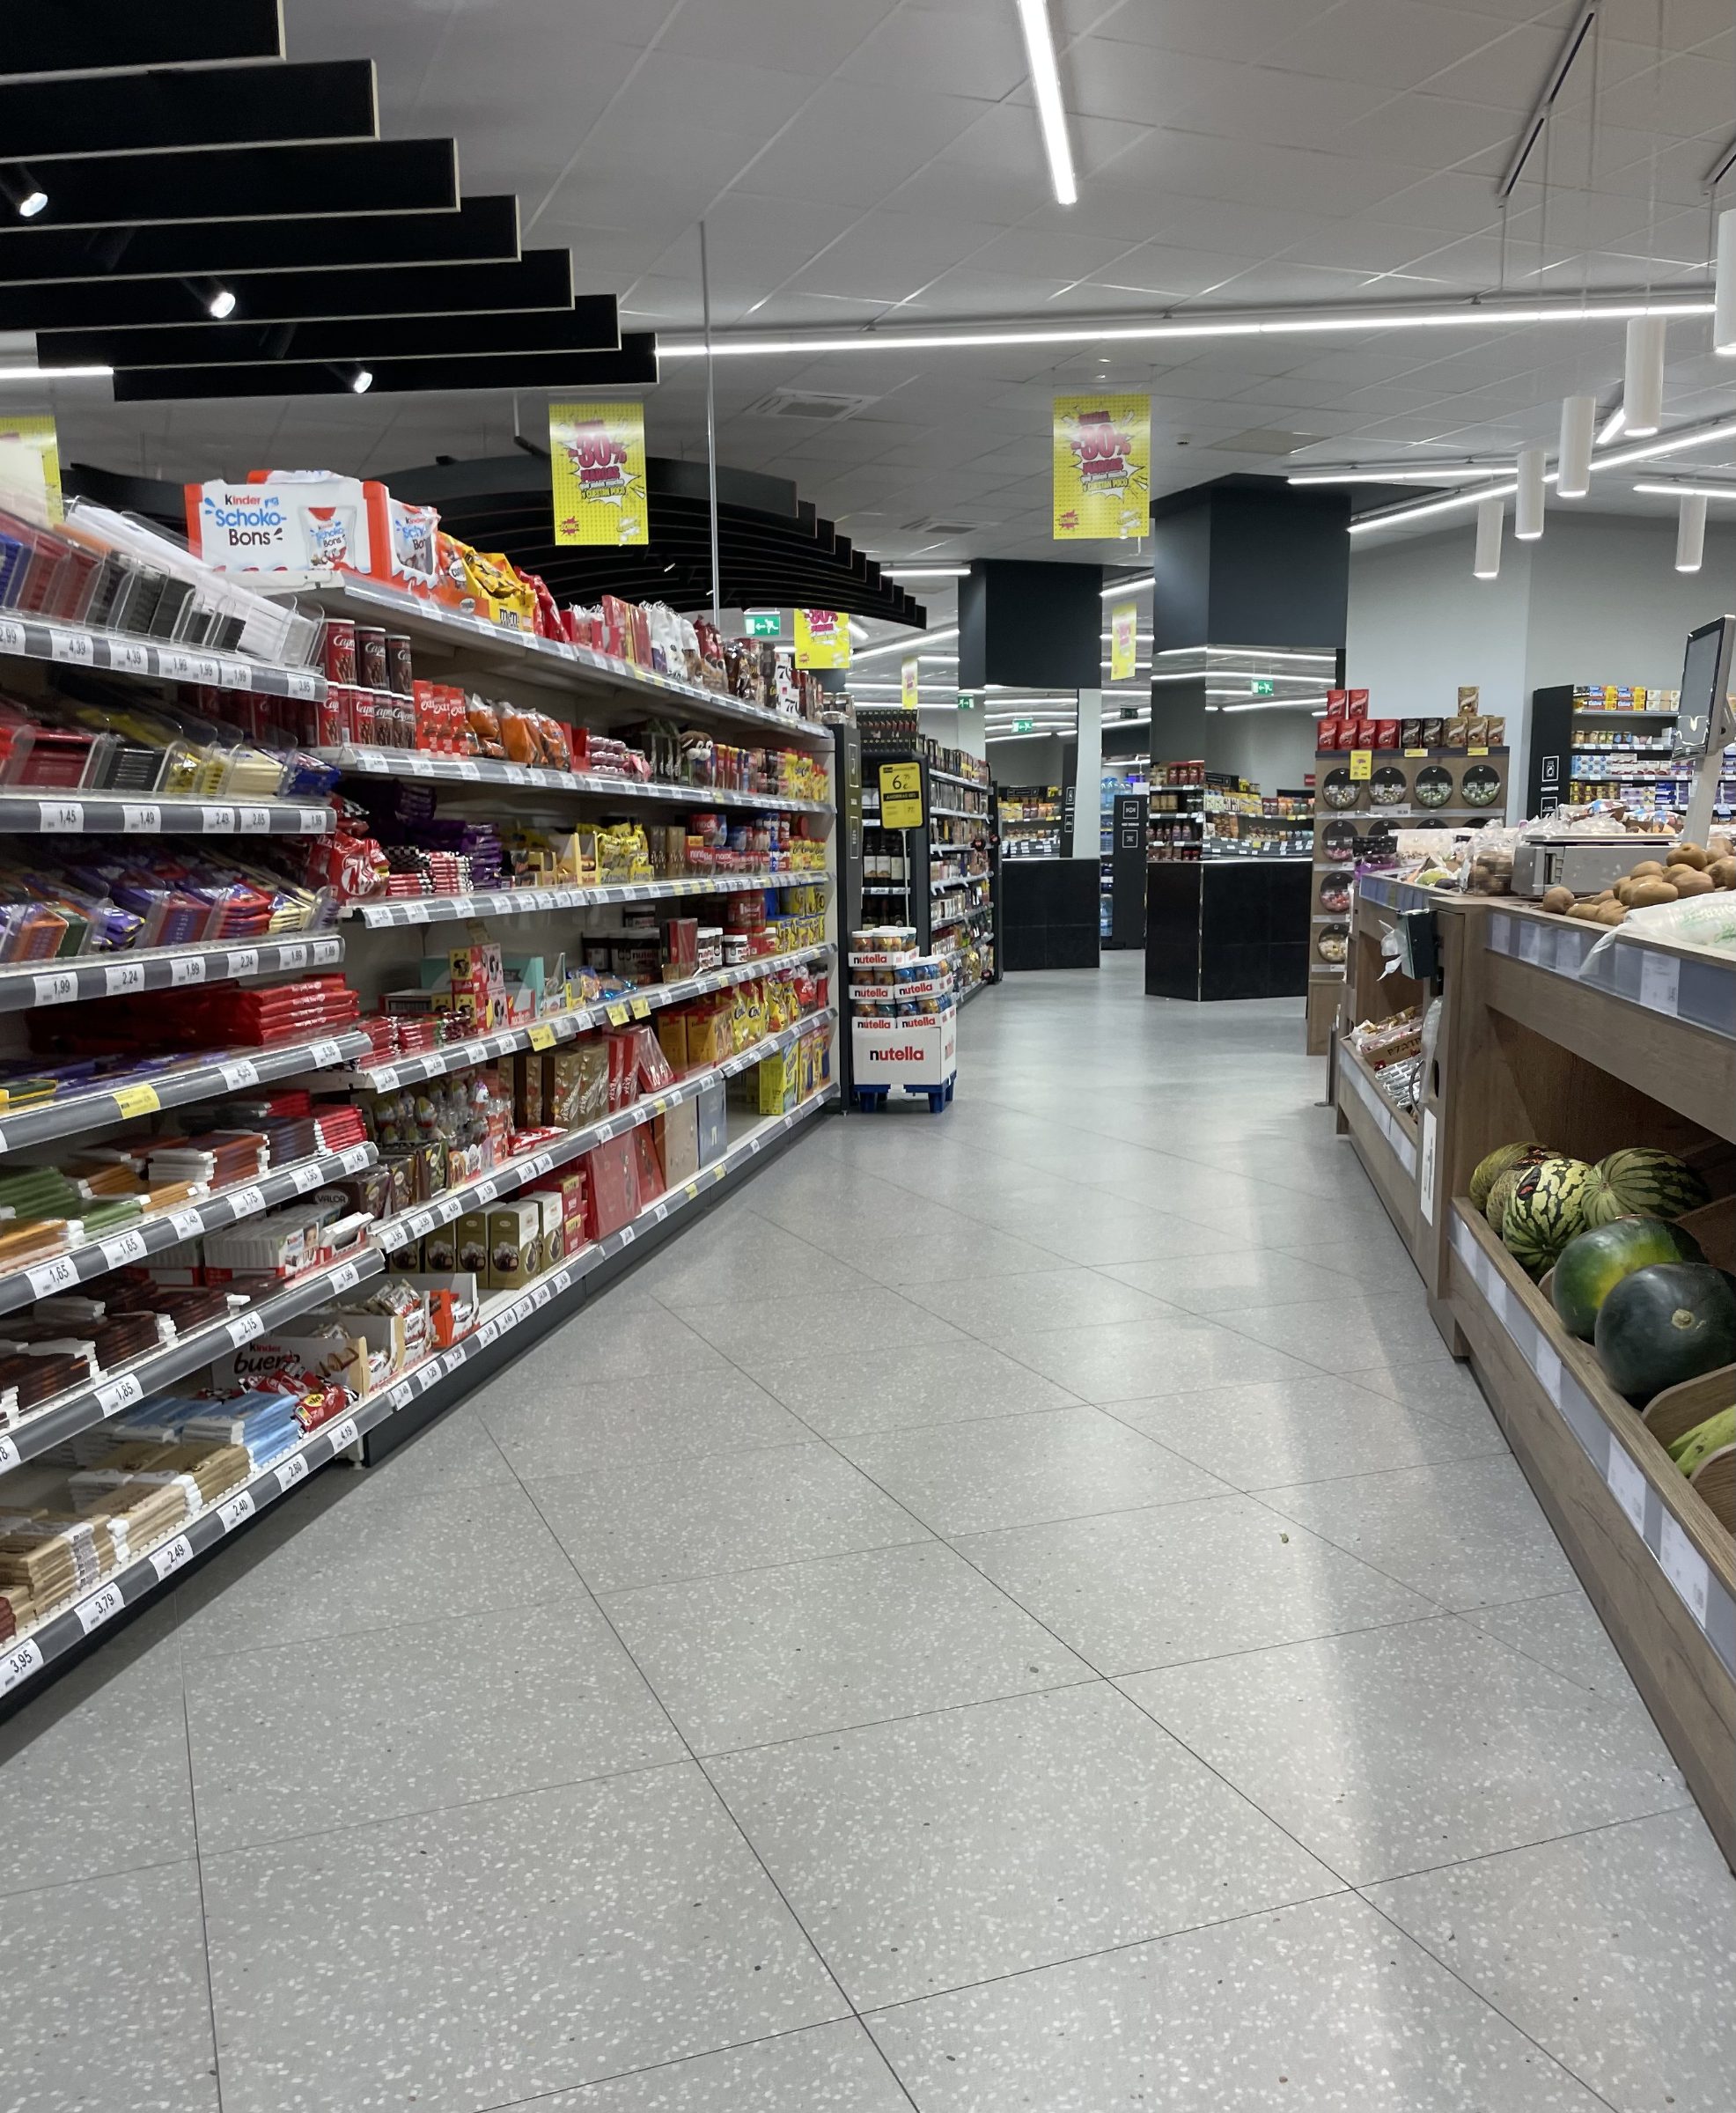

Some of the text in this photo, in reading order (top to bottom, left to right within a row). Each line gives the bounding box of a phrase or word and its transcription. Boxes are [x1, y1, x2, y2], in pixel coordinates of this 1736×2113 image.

[216, 508, 288, 527] Schoko-
[229, 528, 271, 546] Bons
[892, 774, 902, 791] 6
[59, 809, 77, 826] 1,45
[853, 953, 887, 965] nutella
[185, 962, 201, 978] 1,99
[53, 979, 71, 997] 1,99
[855, 988, 888, 998] nutella
[899, 983, 933, 996] nutella
[857, 1019, 891, 1028] nutella
[901, 1016, 936, 1028] nutella
[870, 1046, 924, 1061] nutella
[317, 1194, 345, 1204] VALOR
[120, 1238, 137, 1256] 1,65
[48, 1264, 70, 1285] 1,65
[241, 1317, 257, 1334] 2,15
[115, 1382, 134, 1403] 1,85
[232, 1498, 248, 1517] 2,40
[167, 1543, 185, 1565] 2,49
[94, 1593, 115, 1615] 3,79
[10, 1648, 33, 1675] 3,95
